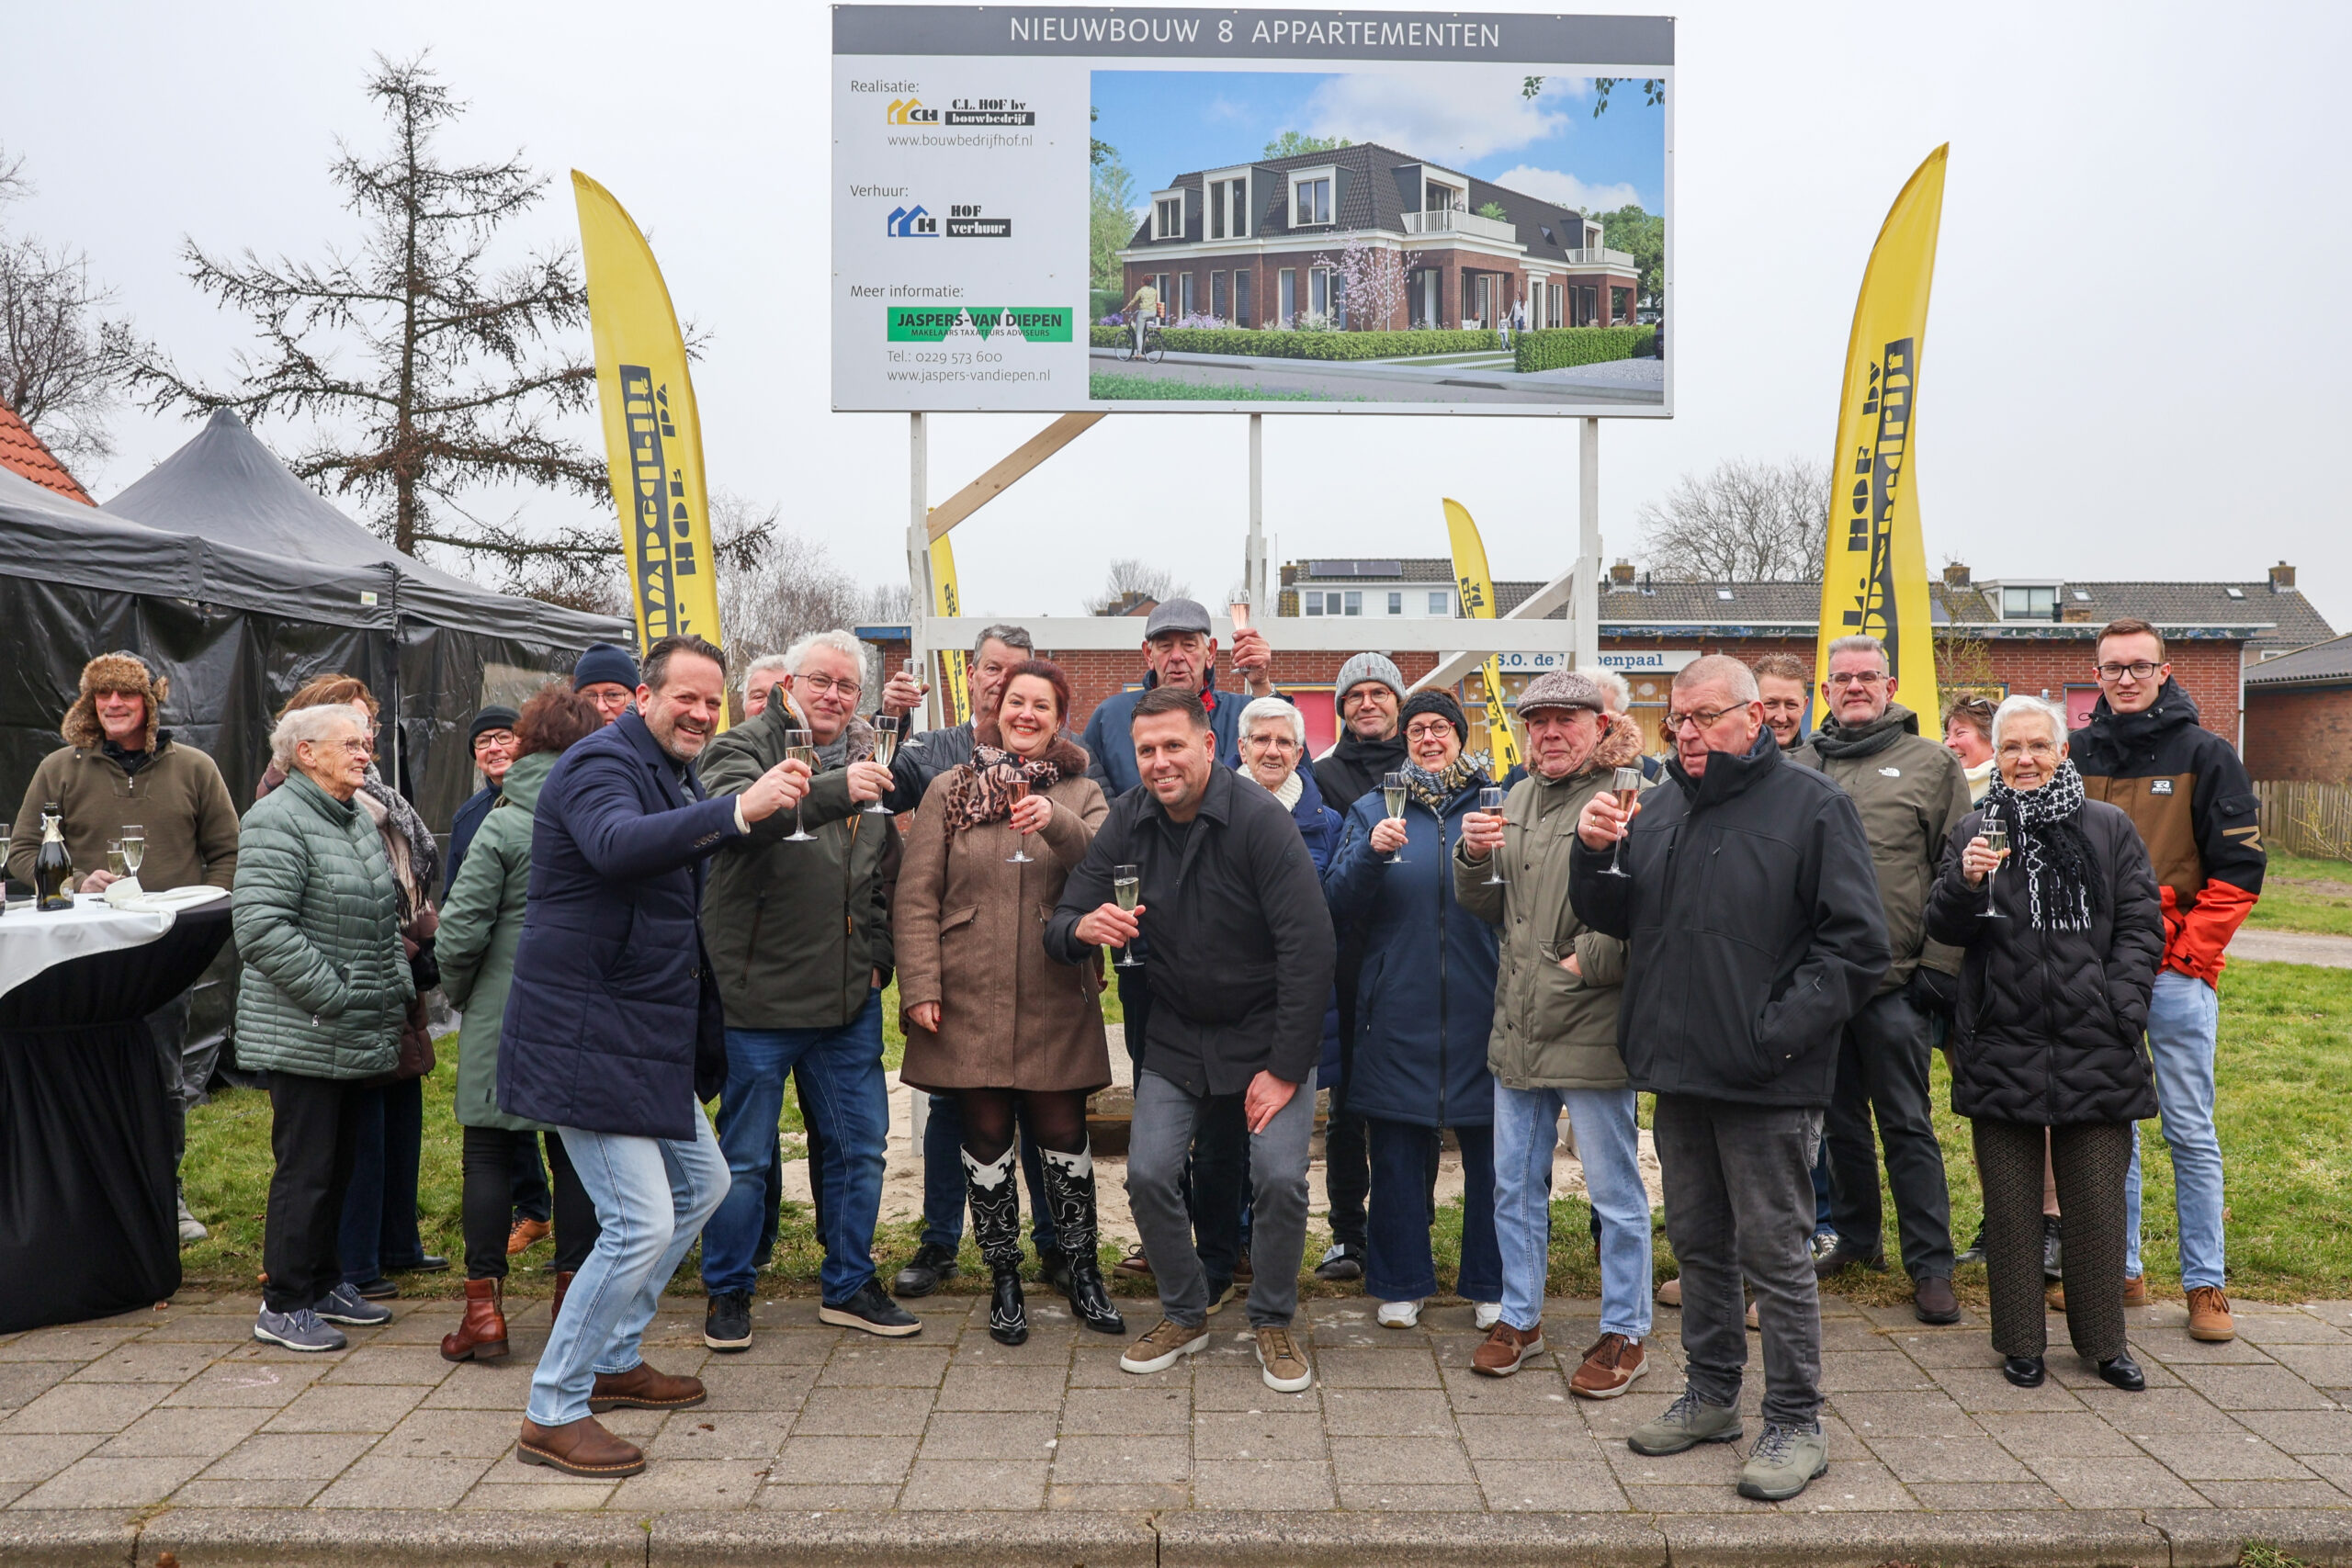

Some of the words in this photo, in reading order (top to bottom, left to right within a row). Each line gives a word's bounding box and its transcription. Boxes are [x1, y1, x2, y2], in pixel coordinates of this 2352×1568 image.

[1011, 17, 1200, 42] NIEUWBOUW
[1217, 20, 1234, 43] 8
[1251, 20, 1499, 47] APPARTEMENTEN
[851, 80, 920, 93] Realisatie:
[952, 98, 976, 110] C.L.
[978, 99, 1008, 110] HOF
[1011, 99, 1026, 110] bv
[952, 113, 1027, 125] bouwbedrijf
[888, 134, 1033, 149] www.bouwbedrijfhof.nl
[851, 185, 909, 197] Verhuur:
[951, 205, 981, 217] HOF
[951, 221, 1006, 234] verhuur
[851, 286, 885, 298] Meer
[889, 285, 964, 298] informatie:
[898, 313, 1001, 327] JASPERS-VAN
[1006, 314, 1062, 327] DIEPEN
[1007, 329, 1049, 337] ADVISEURS
[888, 350, 911, 362] Tel.:
[915, 353, 947, 364] 0229
[951, 353, 972, 365] 573
[976, 351, 1002, 363] 600
[888, 369, 1050, 383] www.jaspers-vandiepen.nl
[1848, 446, 1872, 551] HOF
[1862, 361, 1881, 415] bv
[1864, 352, 1911, 654] ouwbedrijf
[1534, 653, 1554, 666] de
